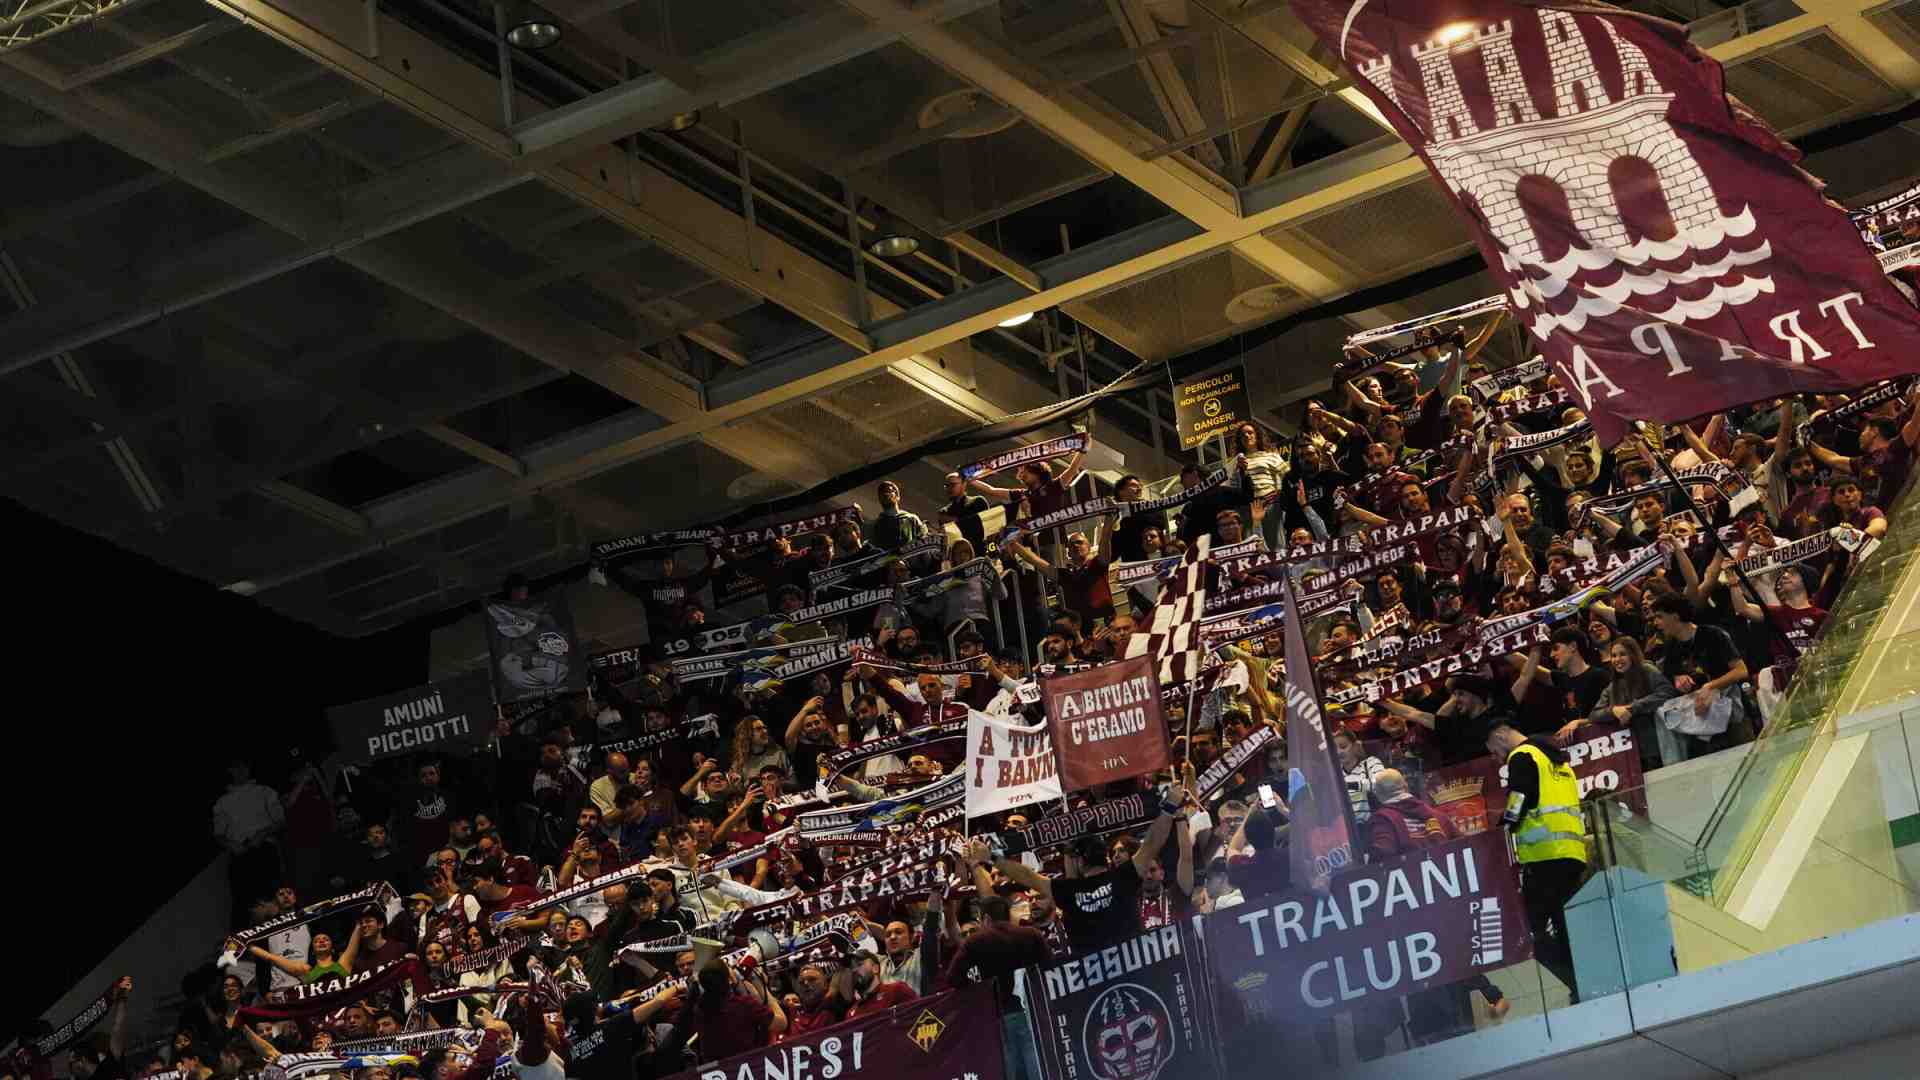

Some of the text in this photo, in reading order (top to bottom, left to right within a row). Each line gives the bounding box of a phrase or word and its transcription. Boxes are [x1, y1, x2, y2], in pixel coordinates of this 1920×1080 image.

[731, 514, 837, 548] TRAPANI
[791, 597, 848, 623] TRAPANI
[367, 714, 470, 756] PICCIOTTI
[978, 726, 994, 755] A
[1071, 707, 1146, 745] C'ERAMO
[801, 814, 852, 830] SHARK
[1023, 793, 1145, 849] TRAPANI
[1237, 847, 1480, 957] TRAPANI
[1044, 923, 1181, 1000] NESSUNA
[1300, 930, 1443, 1009] CLUB
